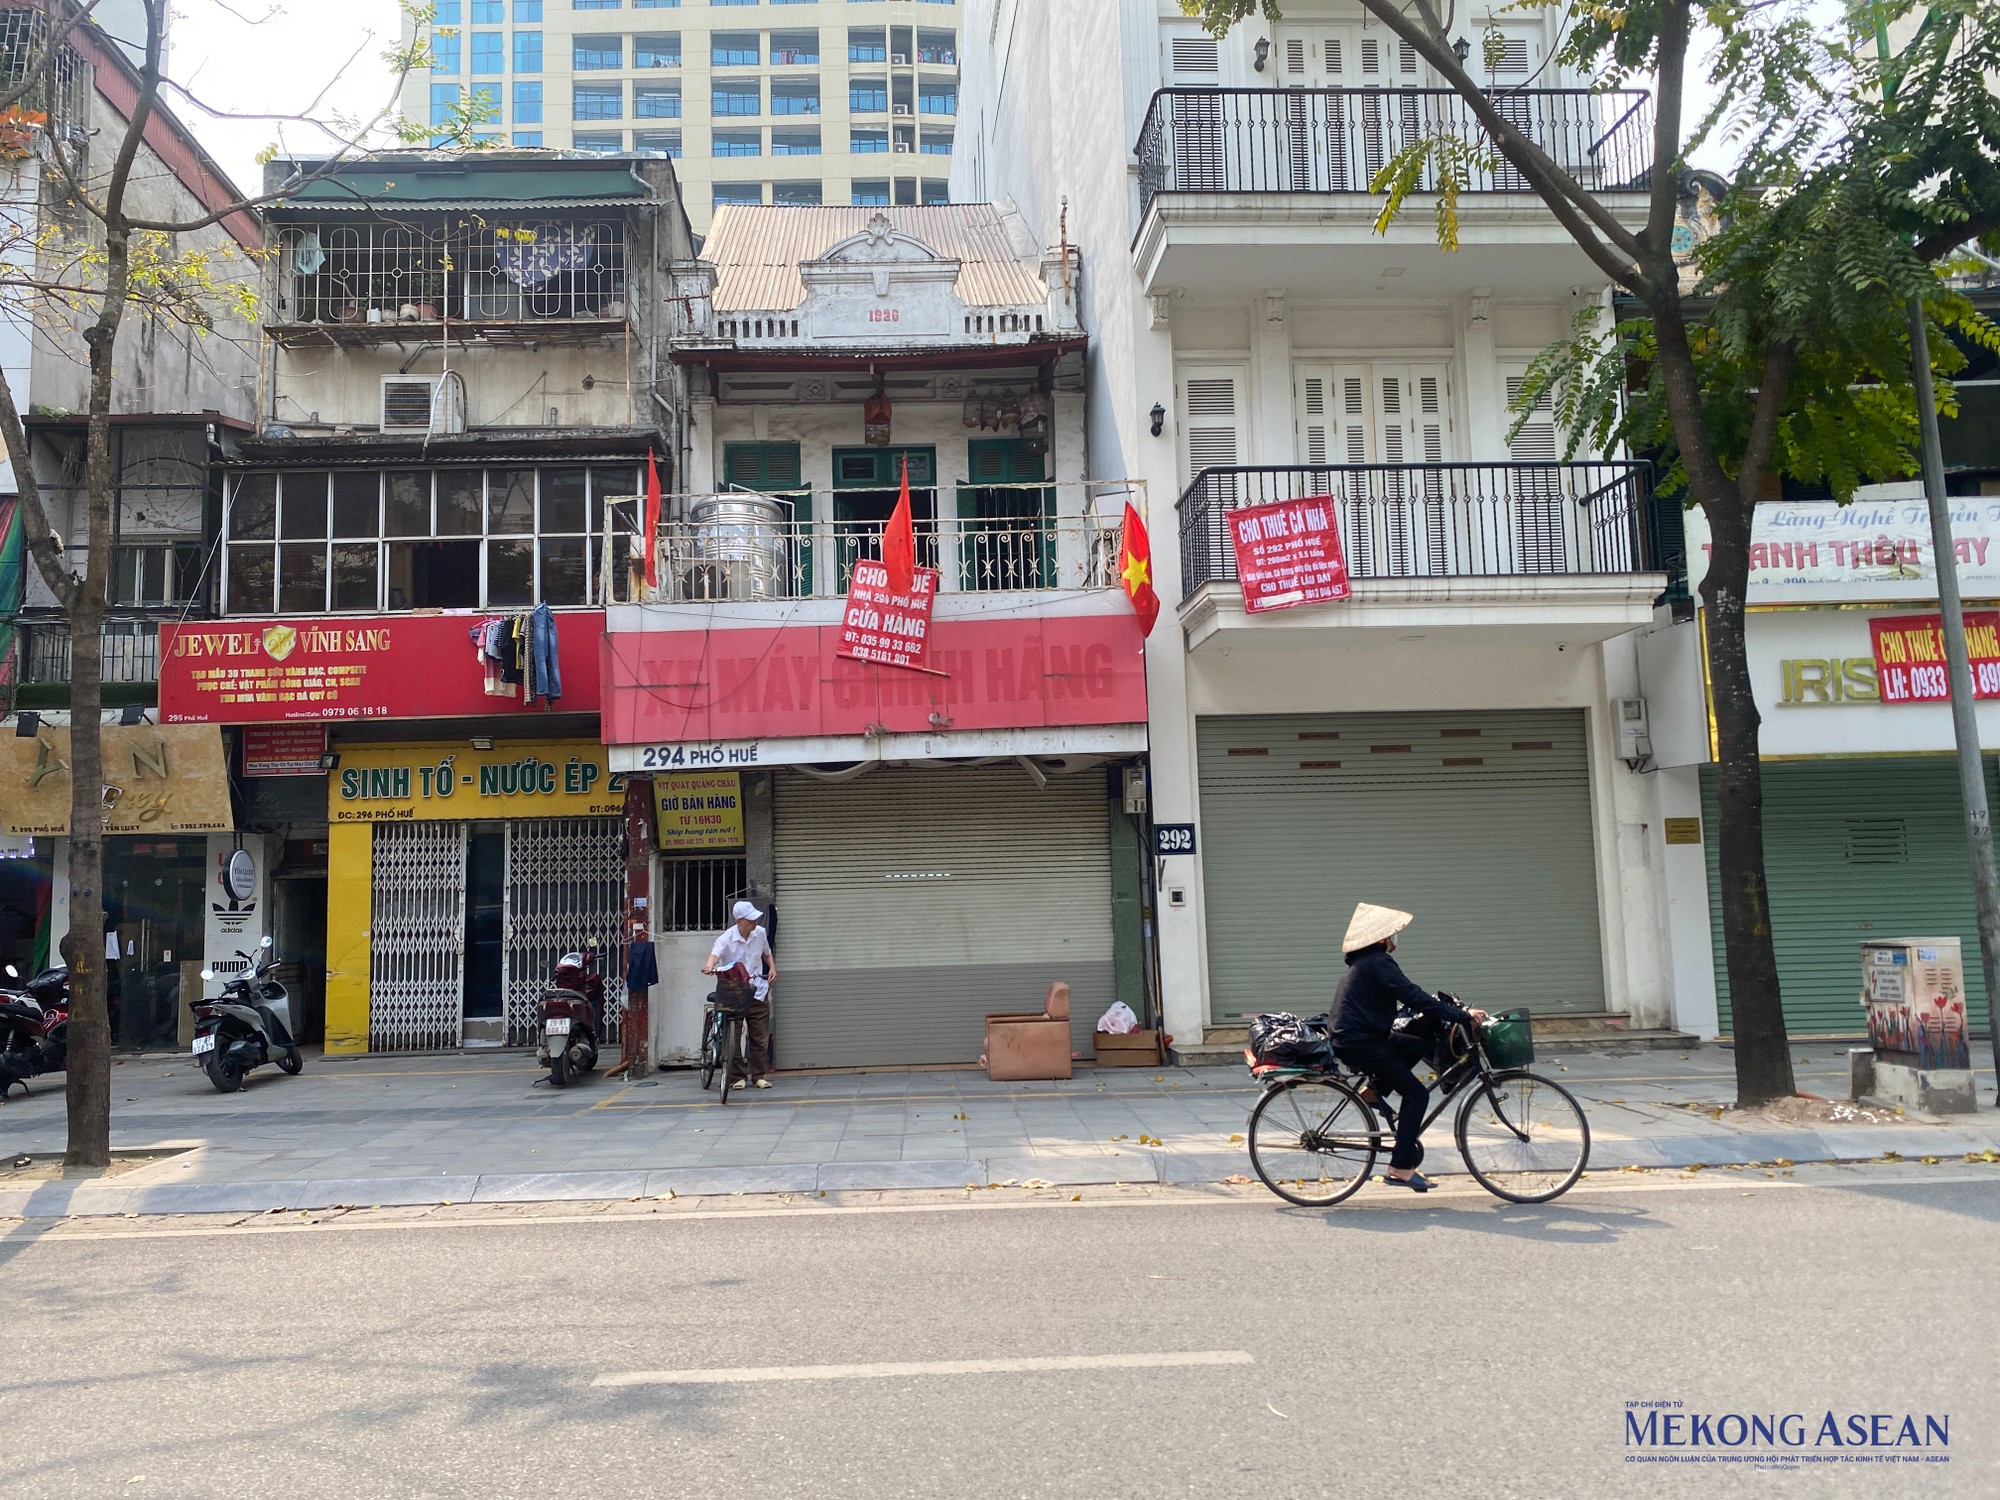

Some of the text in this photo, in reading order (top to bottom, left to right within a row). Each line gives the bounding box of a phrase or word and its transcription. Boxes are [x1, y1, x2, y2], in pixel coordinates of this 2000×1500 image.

[869, 309, 899, 321] 1926
[1238, 503, 1328, 544] CHO THUÊ CẢ NHÀ
[1768, 509, 1825, 529] Làng
[1832, 506, 1895, 529] Nghề
[1902, 503, 1978, 524] Tryền
[1253, 537, 1321, 556] SỐ 292 PHỐ HUẾ
[1701, 534, 1989, 570] TANH THÊU AY
[856, 567, 888, 587] CHO
[1260, 583, 1276, 593] CHO
[1278, 577, 1299, 590] THUÊ
[854, 589, 929, 610] NHÀ 294 PHỐ HUẾ
[847, 603, 926, 638] CỬA HÀNG
[174, 626, 391, 657] JEWEL VĨNH SANG
[861, 634, 877, 645] 035
[879, 638, 890, 648] 99
[892, 641, 903, 651] 33
[905, 642, 921, 654] 662
[1880, 631, 1906, 664] CHO
[1905, 623, 1938, 662] THUÊ
[1964, 619, 2000, 659] HÀNG
[871, 650, 892, 662] 5161
[227, 669, 238, 678] 3D
[240, 668, 265, 677] TRANG
[285, 667, 306, 676] VÀNG
[643, 657, 704, 716] XE
[716, 644, 817, 714] MÁY
[986, 634, 1113, 703] HÃNG
[1780, 658, 1880, 700] IRIS
[1883, 668, 1908, 699] LH:
[1911, 666, 1947, 698] 0933
[239, 679, 254, 691] VẬT
[280, 679, 302, 688] CÔNG
[219, 694, 235, 703] THU
[237, 693, 254, 702] MUA
[256, 692, 277, 702] VÀNG
[322, 707, 345, 716] 0979
[348, 707, 359, 716] 06
[362, 707, 373, 715] 18
[376, 706, 387, 715] 18
[643, 742, 758, 767] 294 PHỐ HUẾ
[340, 767, 411, 799] SINH
[419, 755, 456, 797] TỐ
[479, 757, 556, 796] NƯỚC
[564, 758, 599, 794] ÉP
[671, 781, 690, 791] QUAY
[691, 778, 716, 790] QUẢNG
[717, 778, 736, 788] CHÂU
[661, 793, 736, 811] GIỜ BÁN HÀNG
[375, 807, 415, 818] PHỐ HUẾ
[693, 815, 722, 825] 16H30
[1160, 829, 1191, 849] 292
